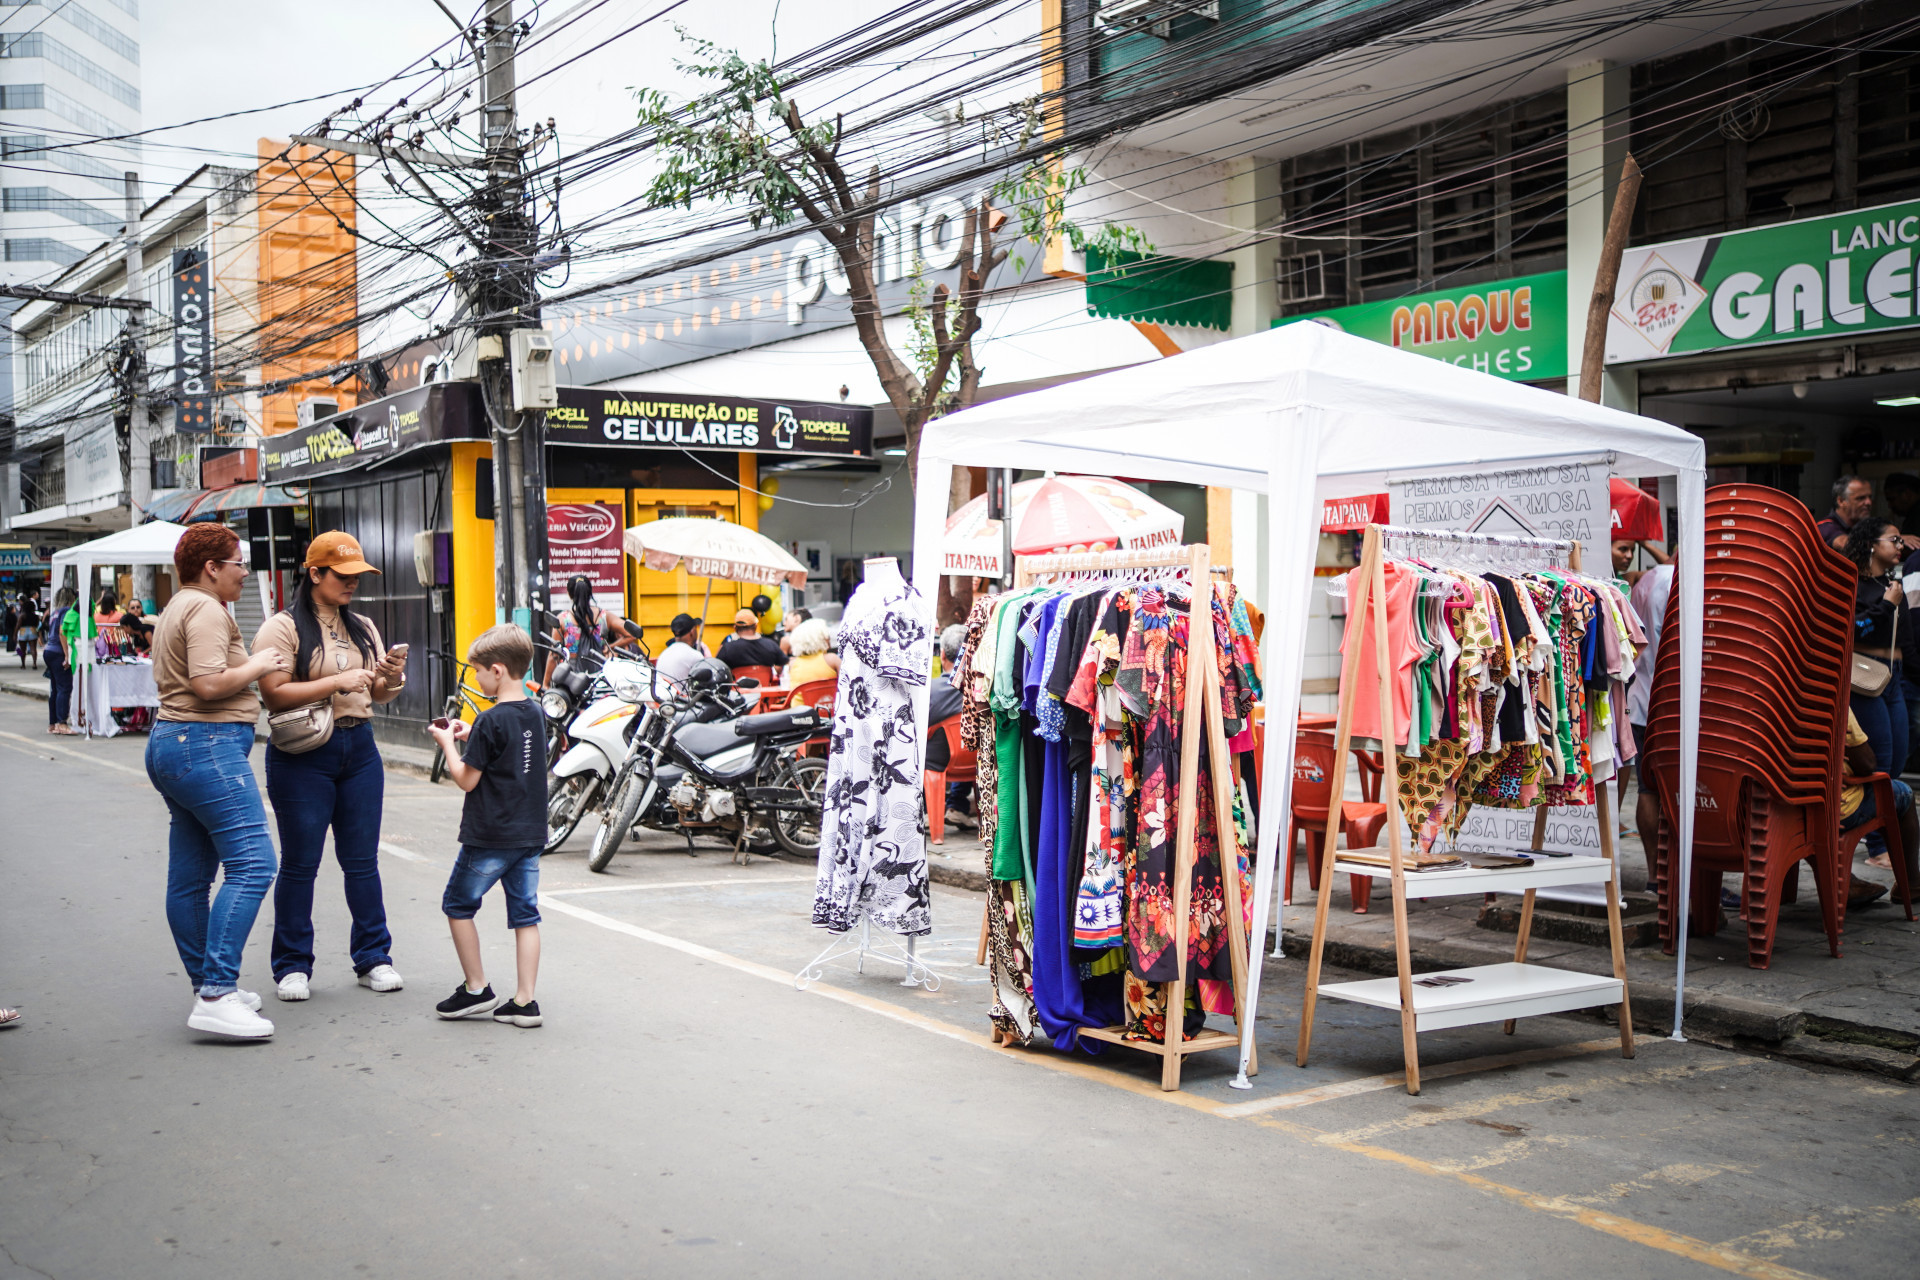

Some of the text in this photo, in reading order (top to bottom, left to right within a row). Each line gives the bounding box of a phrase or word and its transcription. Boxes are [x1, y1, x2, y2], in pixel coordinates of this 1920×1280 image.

[1711, 246, 1920, 340] GALE
[1392, 286, 1532, 348] PARQUE
[1636, 301, 1679, 327] Bar
[604, 399, 759, 424] MANUTENÇÃO DE
[603, 418, 760, 447] CELULARES
[799, 419, 850, 435] TOPCELL
[1402, 463, 1591, 498] PERMOSA PERMOSA
[1129, 528, 1179, 551] ITAIPAVA
[692, 558, 778, 583] PURO MALTE
[944, 553, 999, 572] ITAIPAVA
[1506, 819, 1600, 848] PEMOSA
